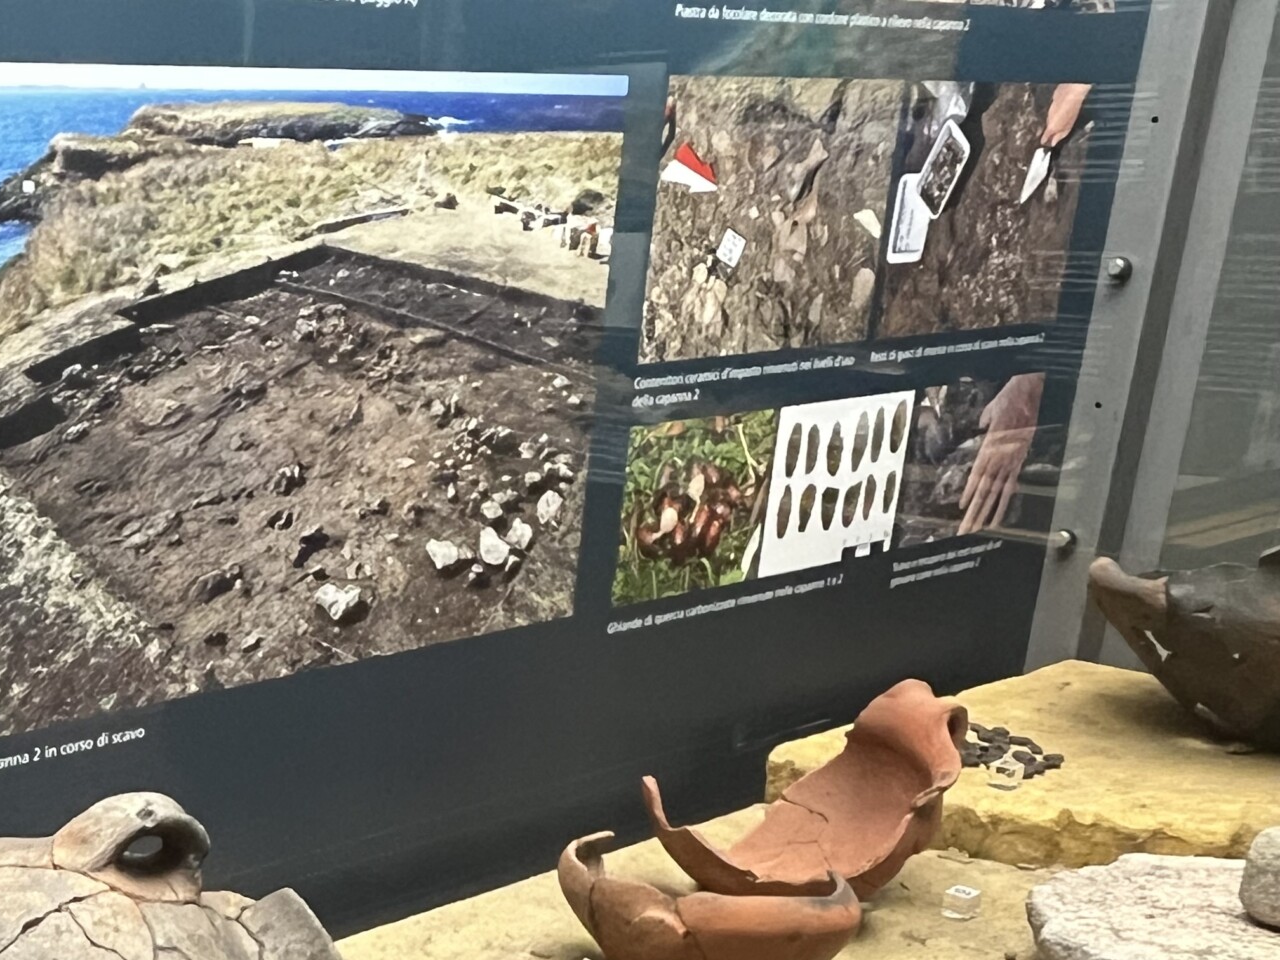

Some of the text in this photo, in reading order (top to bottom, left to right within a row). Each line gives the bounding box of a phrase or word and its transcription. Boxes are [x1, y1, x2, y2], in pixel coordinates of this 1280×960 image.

[32, 746, 42, 763] 2
[44, 744, 58, 759] in
[59, 738, 95, 757] corso
[96, 731, 111, 749] di
[111, 727, 146, 745] scavo
